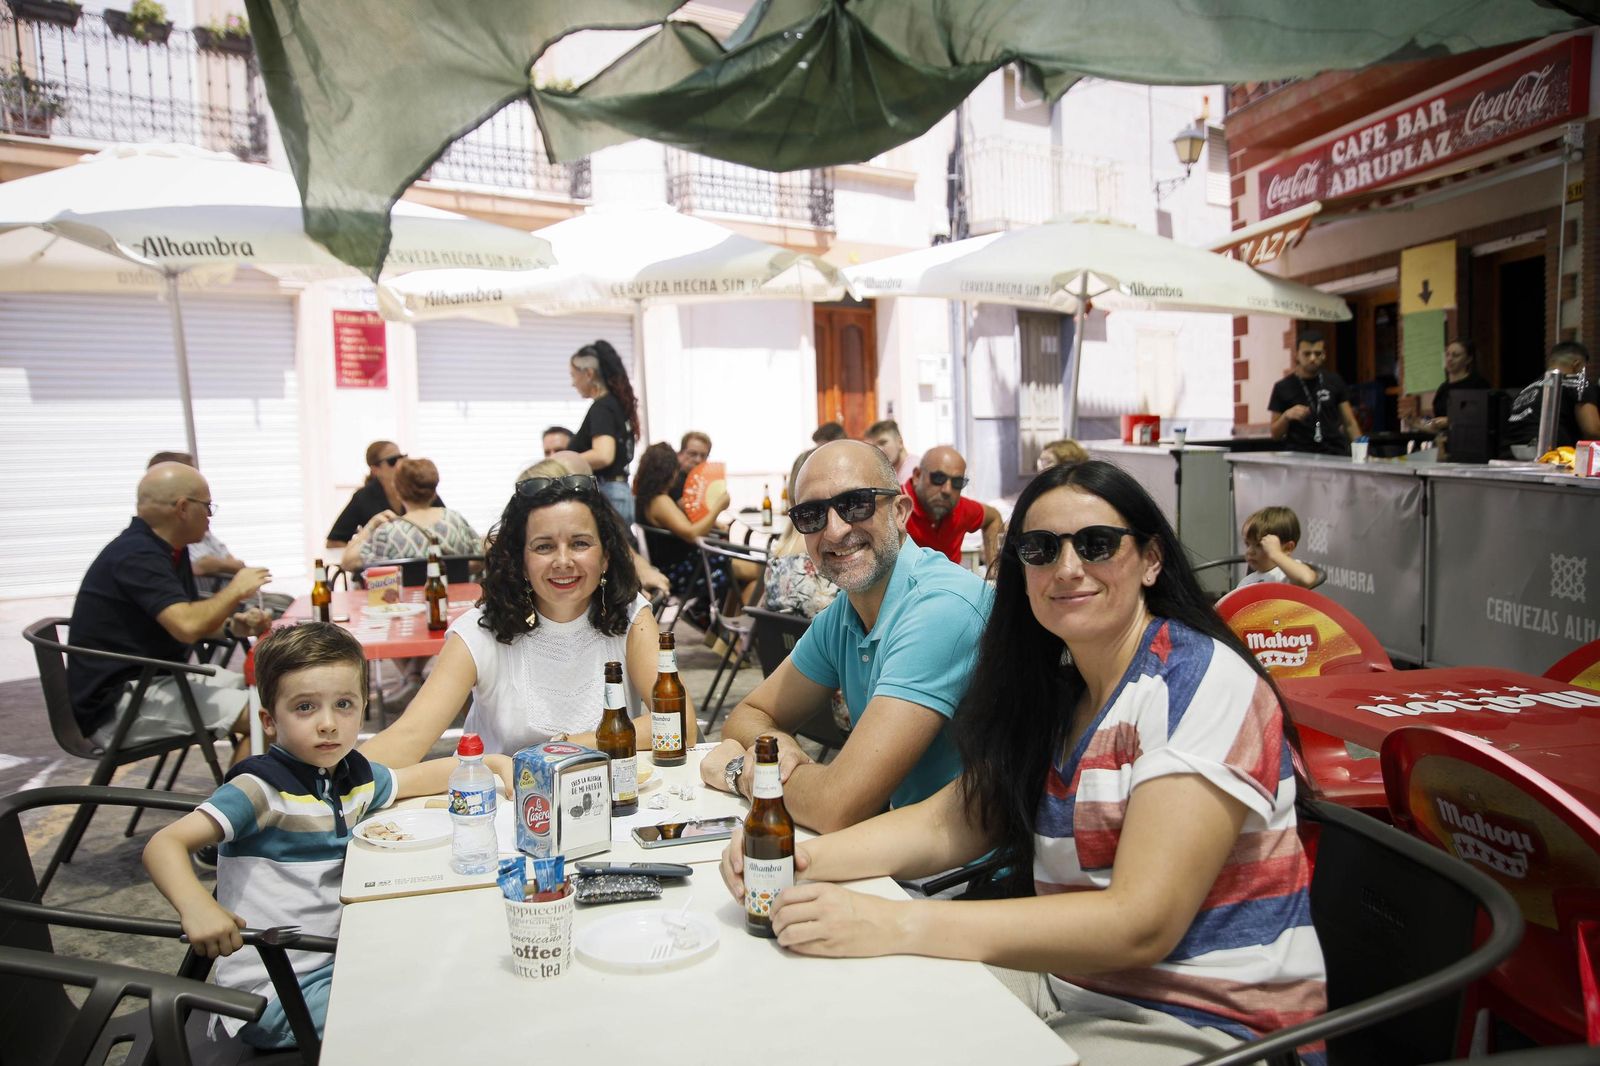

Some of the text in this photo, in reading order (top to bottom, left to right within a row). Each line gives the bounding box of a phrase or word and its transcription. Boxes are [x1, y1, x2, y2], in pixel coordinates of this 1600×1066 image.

[1330, 98, 1448, 165] CAFE BAR
[1327, 132, 1452, 198] ABRUPLAZ
[133, 235, 254, 258] Alhambra
[424, 286, 503, 307] Alhambra
[610, 279, 668, 299] CERVEZA
[673, 278, 722, 294] HECHA
[723, 278, 745, 292] SIN
[960, 279, 993, 293] CERVEZA
[995, 280, 1022, 295] HECHA
[1129, 280, 1183, 297] Alhambra
[1318, 564, 1375, 594] HAMBRA
[1486, 597, 1600, 643] CERVEZAS ALH
[1246, 631, 1314, 649] Mahou
[1436, 796, 1535, 853] Mahou
[749, 861, 782, 873] Alhambra
[540, 962, 560, 978] tea
